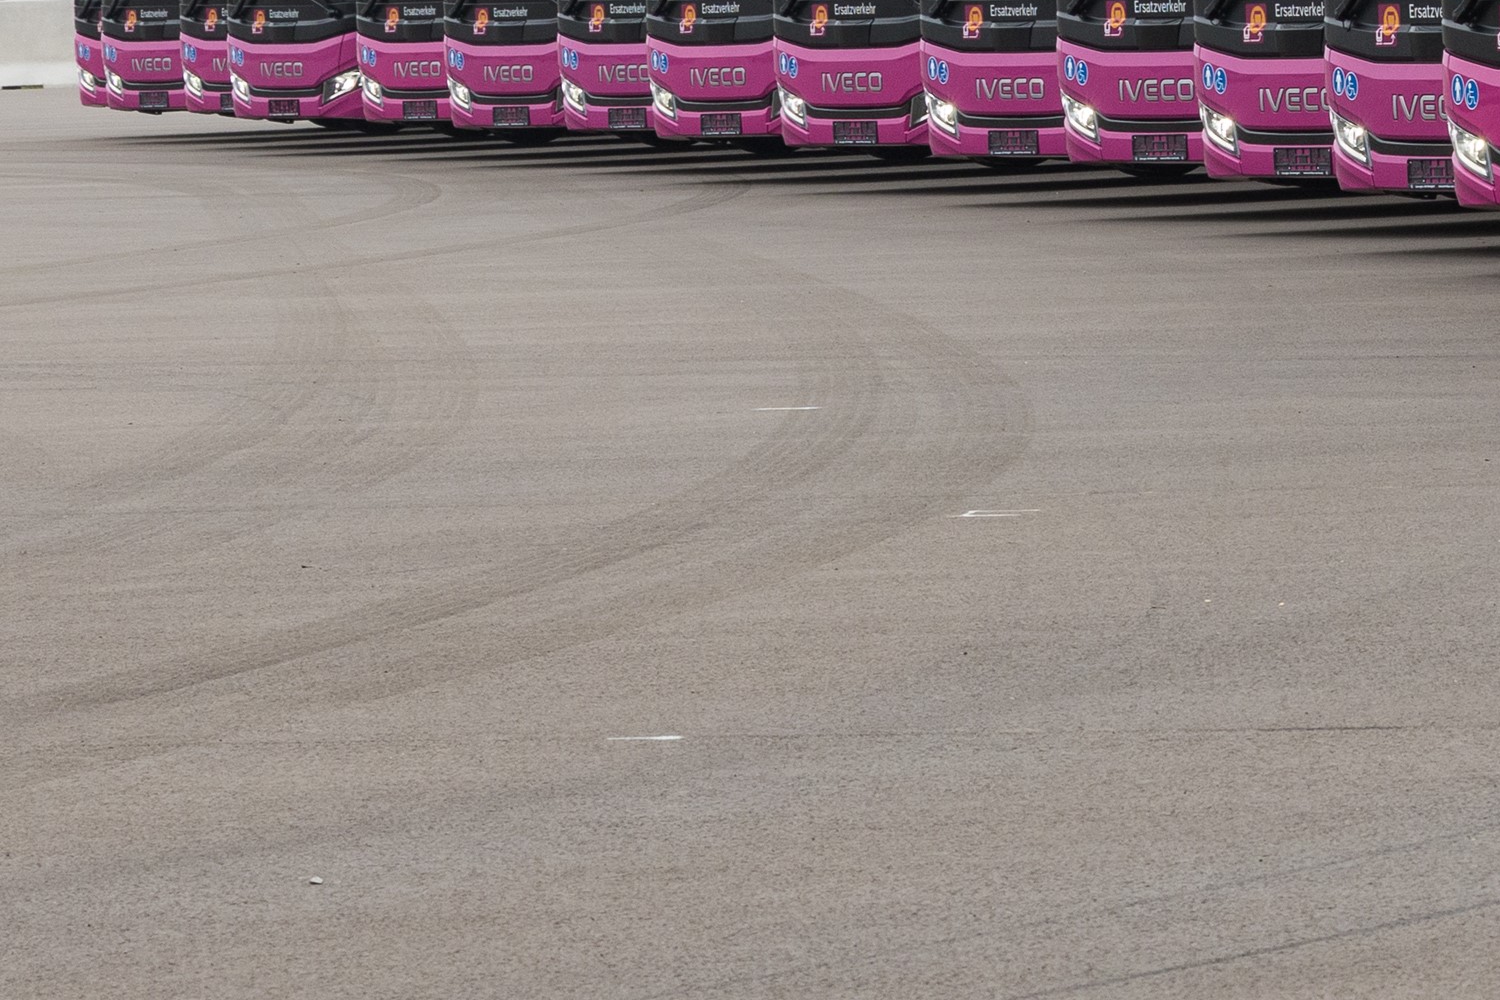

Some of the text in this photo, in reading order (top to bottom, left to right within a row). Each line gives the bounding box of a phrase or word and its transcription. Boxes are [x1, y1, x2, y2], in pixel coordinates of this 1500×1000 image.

[701, 2, 740, 14] Ersatzverkehr
[834, 3, 876, 15] Ersatzverkehr
[989, 4, 1038, 17] Ersatzverkehr
[131, 57, 172, 72] IVECO
[260, 62, 303, 77] IVECO
[394, 61, 441, 78] IVECO
[483, 64, 534, 83] IVECO
[690, 67, 746, 87] IVECO
[821, 72, 883, 93] IVECO
[975, 77, 1045, 100] IVECO
[1118, 78, 1195, 102] IVECO
